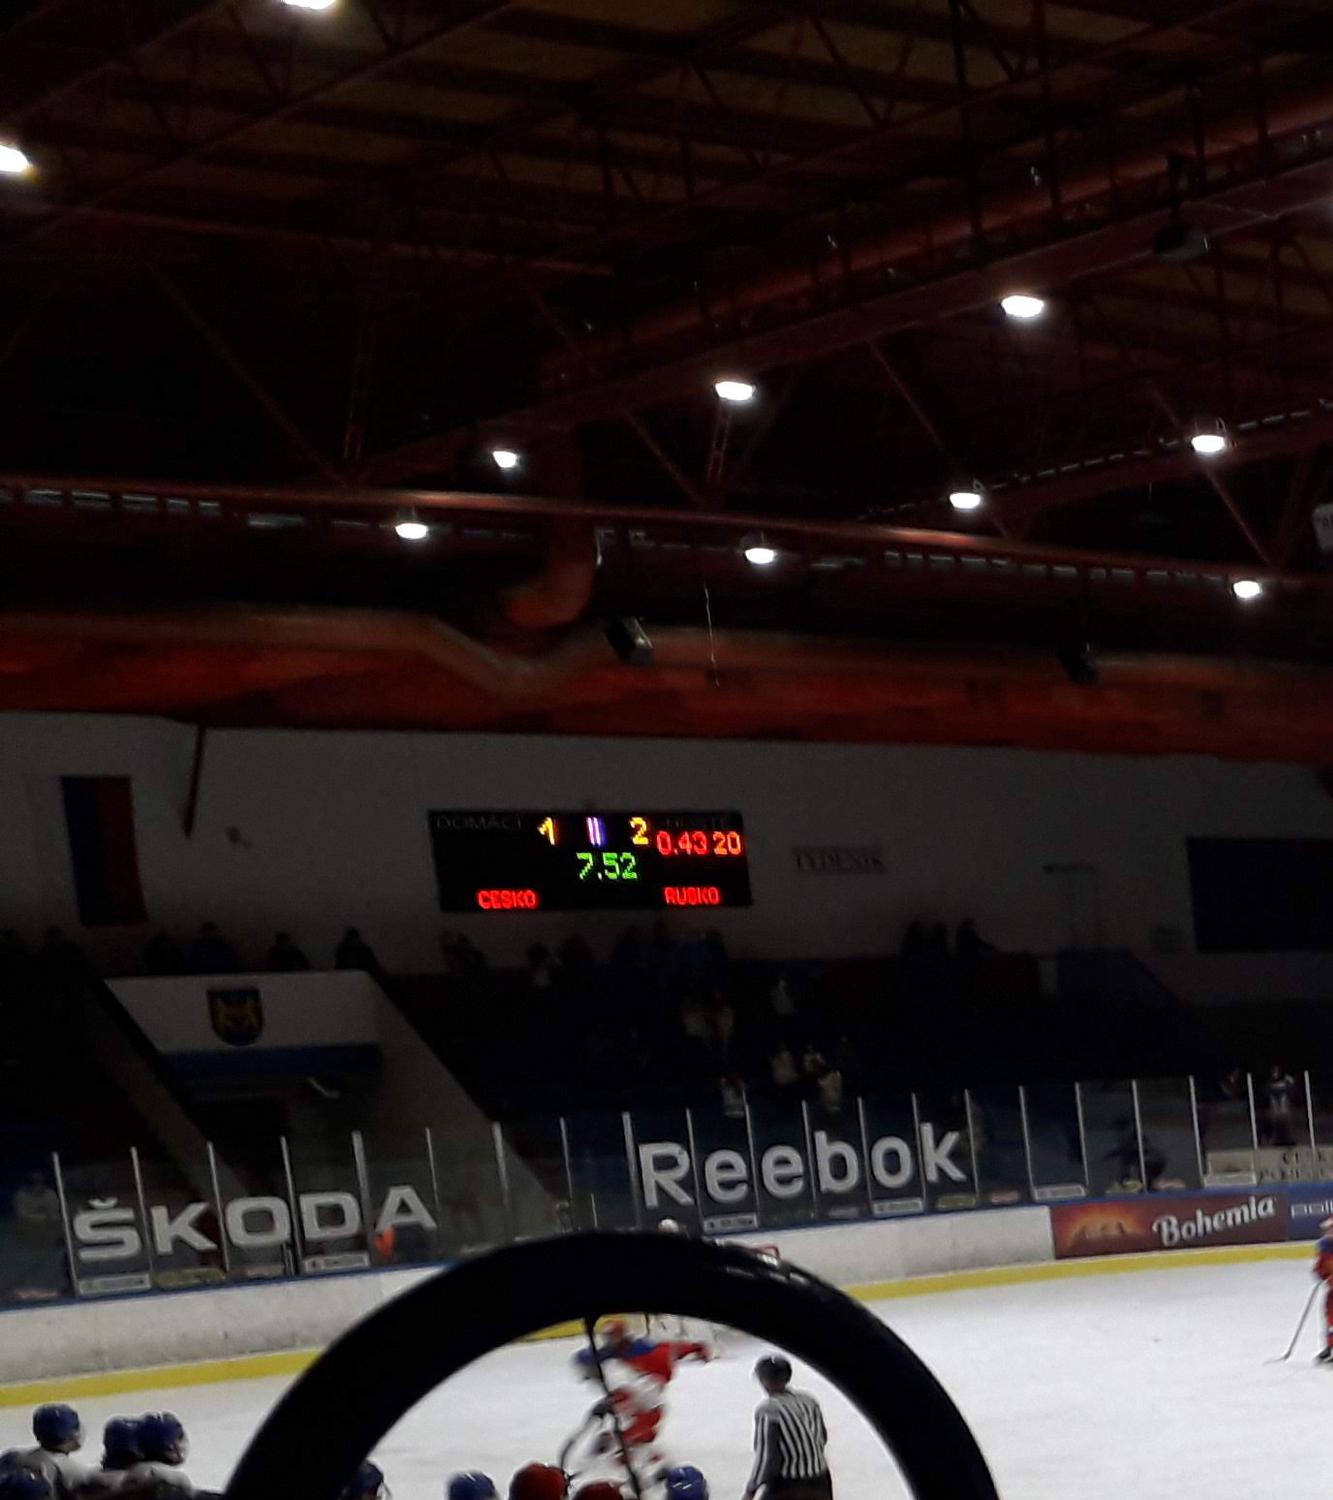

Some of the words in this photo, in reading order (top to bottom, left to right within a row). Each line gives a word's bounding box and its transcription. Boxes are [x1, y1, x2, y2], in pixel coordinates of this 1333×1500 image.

[537, 816, 555, 846] 1
[629, 816, 649, 846] 2
[713, 831, 742, 855] 20
[575, 852, 638, 881] 7.52
[663, 886, 721, 906] RUSKO
[638, 1122, 968, 1210] Reebok
[72, 1185, 438, 1262] ŠKODA
[1152, 1195, 1277, 1247] Bohemia
